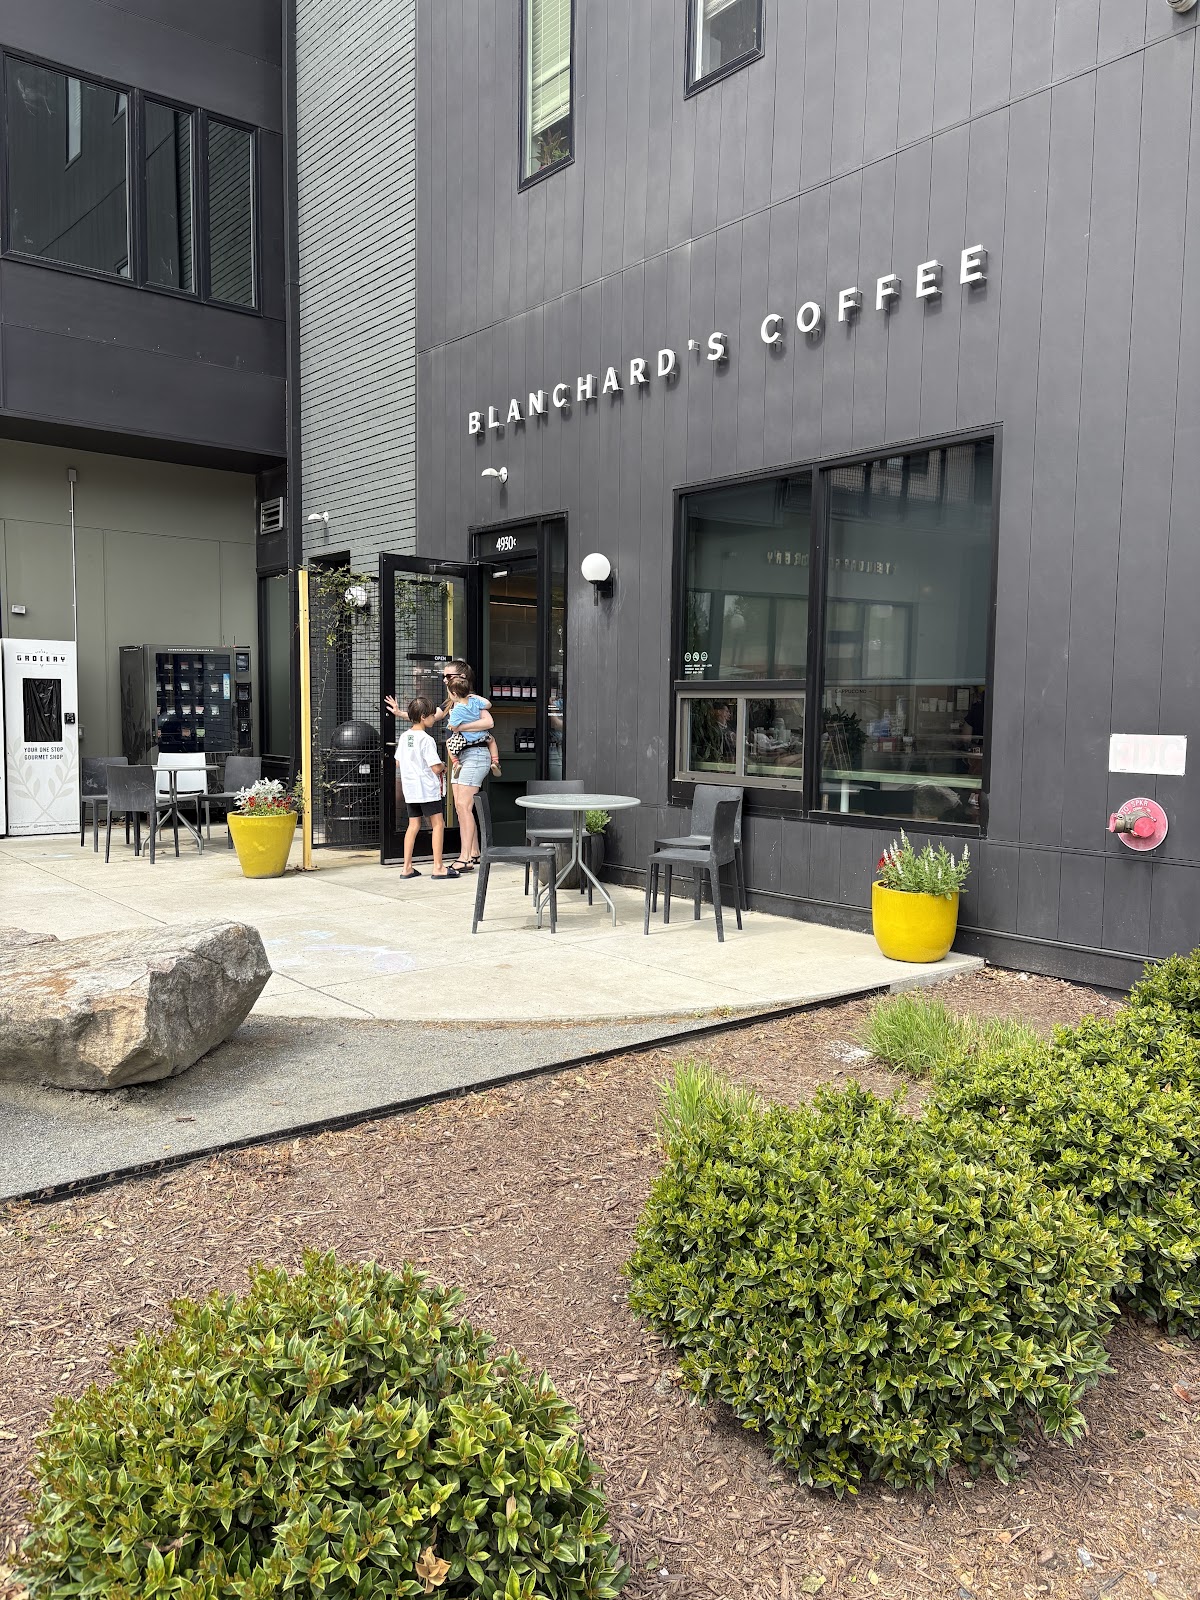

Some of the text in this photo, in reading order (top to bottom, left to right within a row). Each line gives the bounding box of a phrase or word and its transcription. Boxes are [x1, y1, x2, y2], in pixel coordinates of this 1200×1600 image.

[468, 244, 987, 435] BLANCHARD'S COFFEE
[17, 655, 66, 663] GROCERY
[1130, 799, 1148, 807] SPKR
